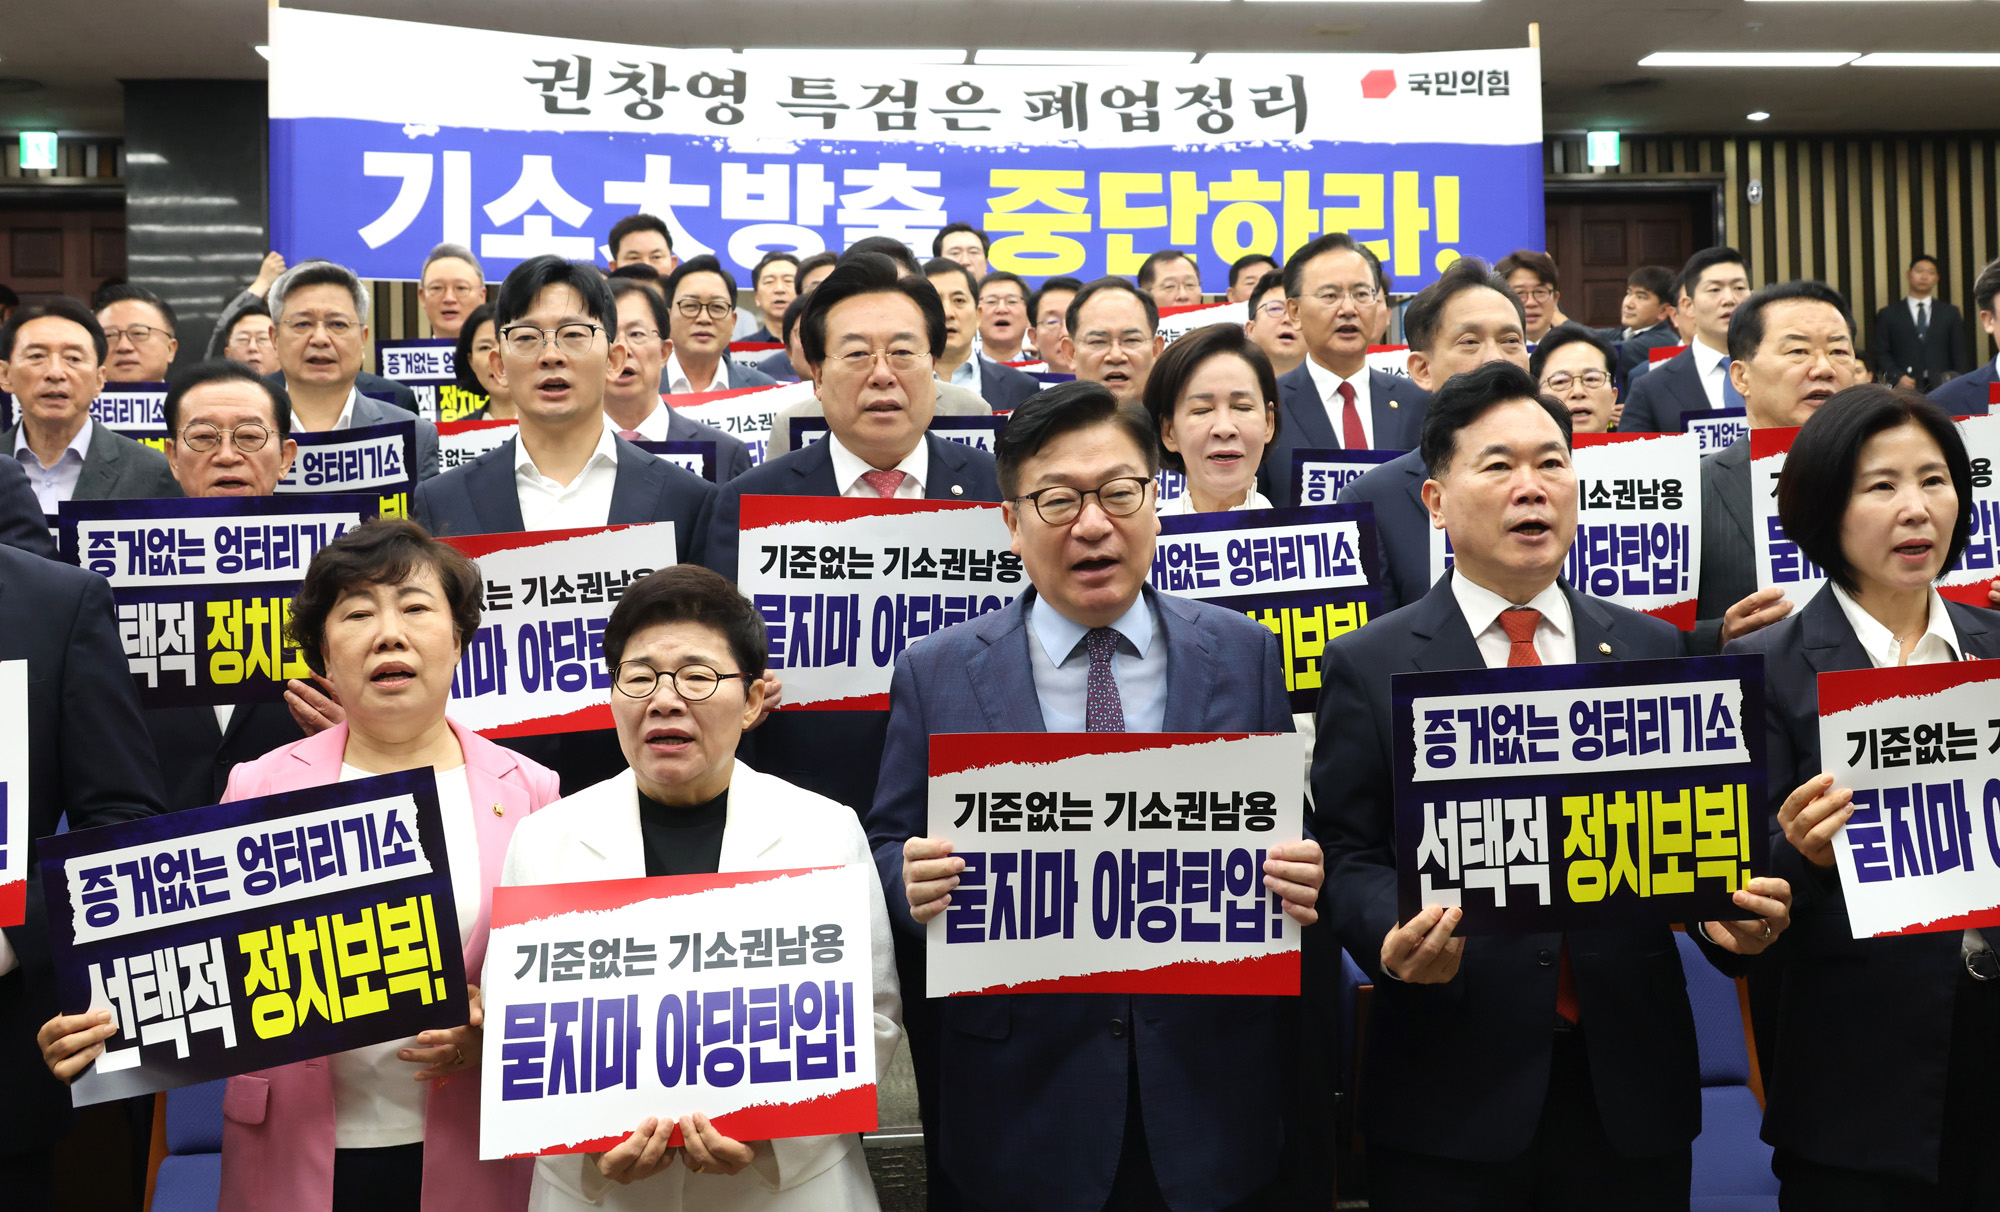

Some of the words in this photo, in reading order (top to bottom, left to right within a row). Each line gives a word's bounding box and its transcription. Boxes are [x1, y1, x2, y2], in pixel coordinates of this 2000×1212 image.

[522, 54, 747, 126] 권창영
[776, 76, 1002, 132] 특검은
[1023, 74, 1309, 135] 폐업정리
[1408, 69, 1511, 97] 국민의힘
[983, 168, 1460, 277] 중단하라!
[387, 352, 439, 375] 증거없는
[438, 448, 476, 467] 없는
[726, 412, 777, 433] 기소권
[303, 444, 401, 486] 엉터리기소
[1308, 469, 1364, 501] 증거
[87, 526, 206, 577] 증거없는
[760, 545, 875, 580] 기준없는
[882, 546, 1023, 584] 기소권남용
[1151, 543, 1221, 591] 거없는
[1226, 531, 1358, 587] 엉터리기소
[1560, 522, 1689, 597] 야당탄압!
[114, 601, 196, 688] 택적
[518, 615, 612, 693] 야당탄
[753, 593, 861, 670] 묻지마
[1424, 703, 1560, 769] 증거없는
[1569, 692, 1738, 762] 엉터리기소
[1846, 722, 1978, 770] 기준없는
[953, 791, 1094, 833] 기준없는
[1104, 790, 1277, 832] 기소권남용
[1417, 796, 1552, 911] 선택적
[1561, 783, 1752, 903] 정치보복!
[1845, 778, 1973, 884] 묻지마
[79, 846, 231, 929] 증거없는
[236, 808, 417, 897] 엉터리기소
[946, 848, 1078, 944] 묻지마
[87, 937, 238, 1075] 선택적
[237, 894, 447, 1040] 정치보복!
[514, 937, 657, 983] 기준없는
[668, 923, 845, 973] 기소권남용
[502, 994, 641, 1102] 묻지마
[656, 980, 857, 1088] 야당탄압!
